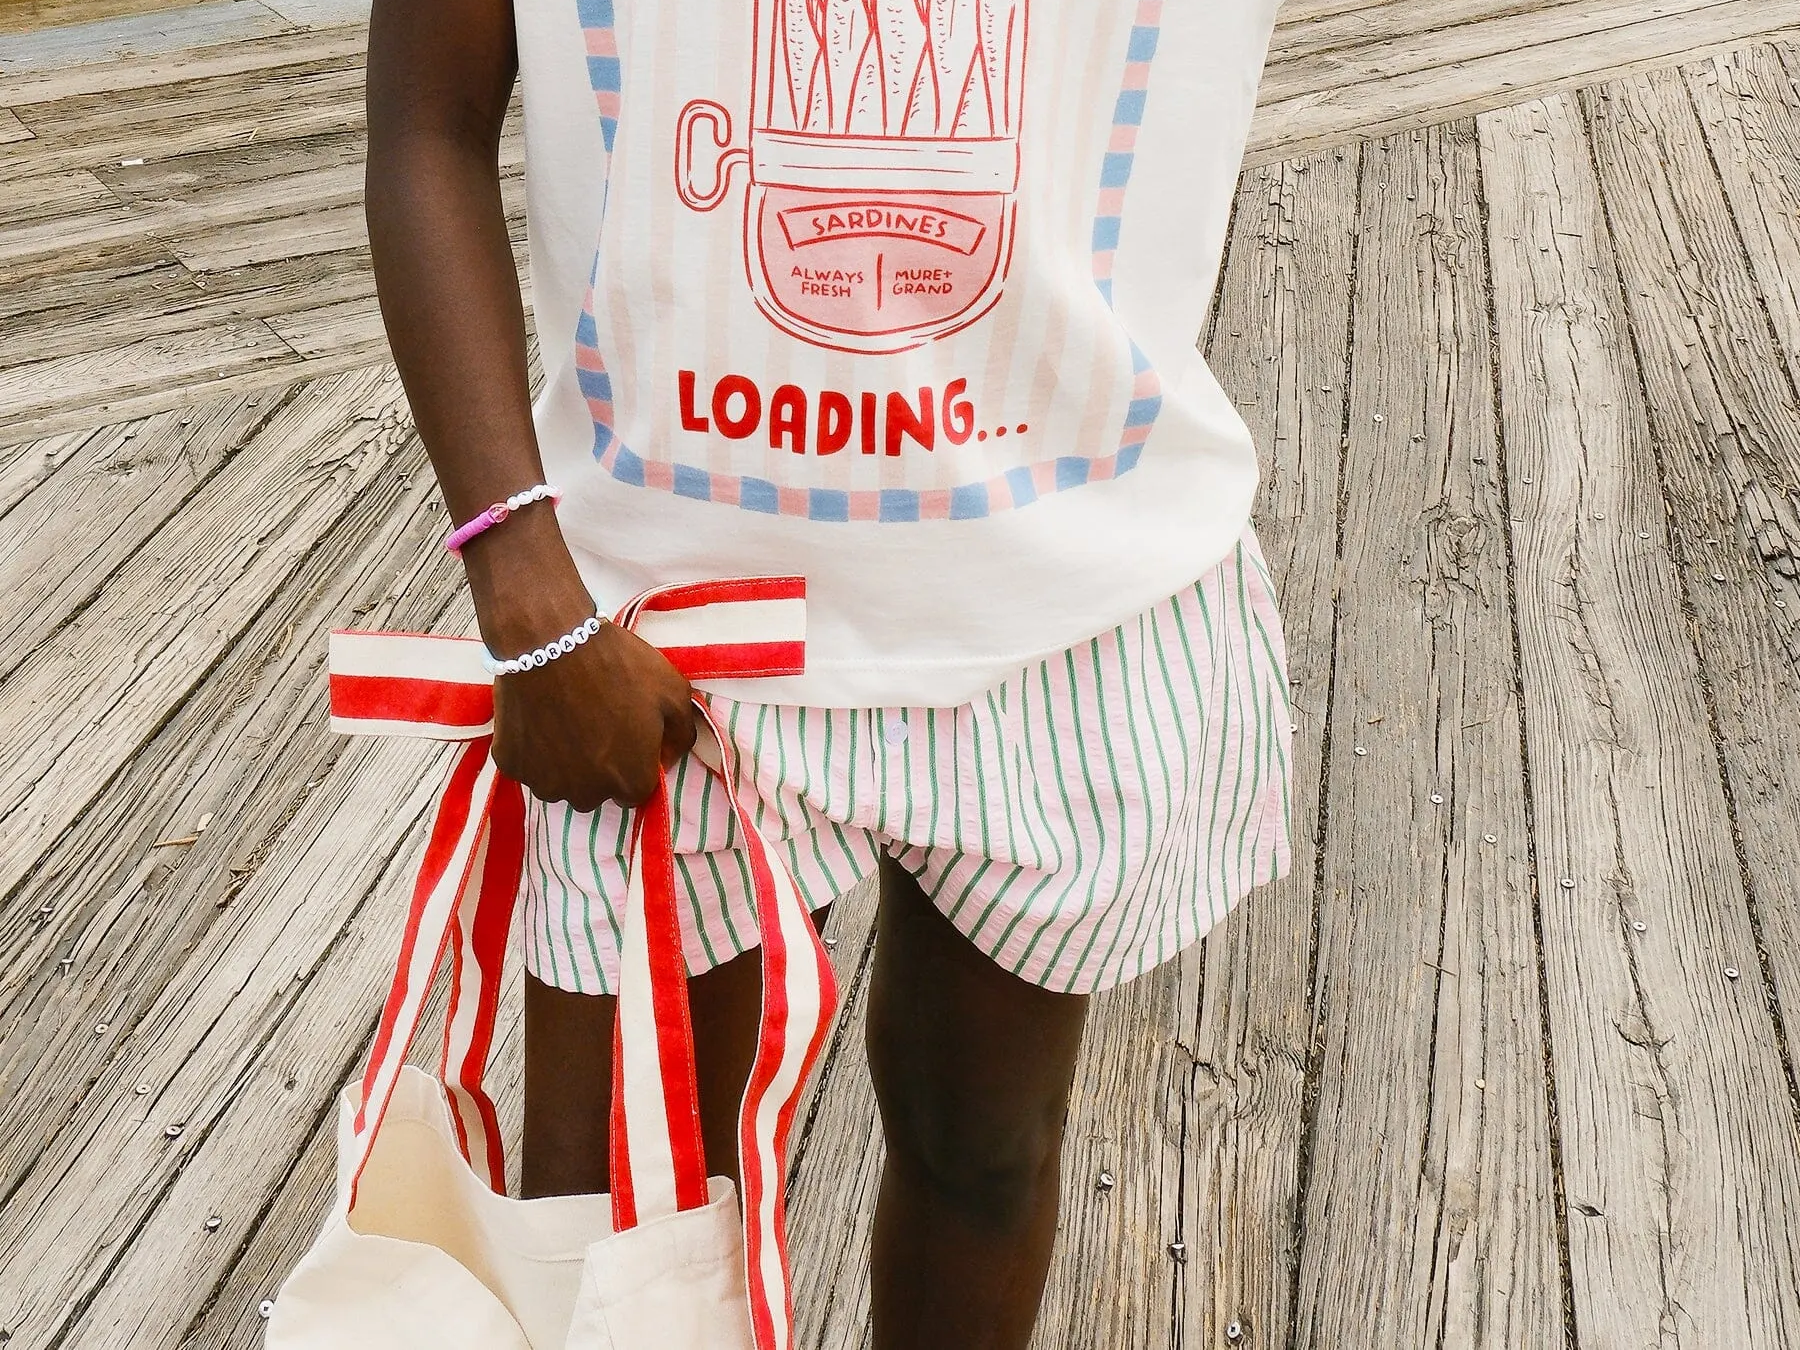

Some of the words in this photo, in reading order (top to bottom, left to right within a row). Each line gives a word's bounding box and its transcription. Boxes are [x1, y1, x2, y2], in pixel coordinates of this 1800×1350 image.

[812, 208, 948, 238] SARDINES
[790, 265, 864, 284] ALWAYS
[801, 281, 851, 298] FRESH
[892, 282, 953, 296] GRAND
[677, 369, 1029, 457] LOADING...
